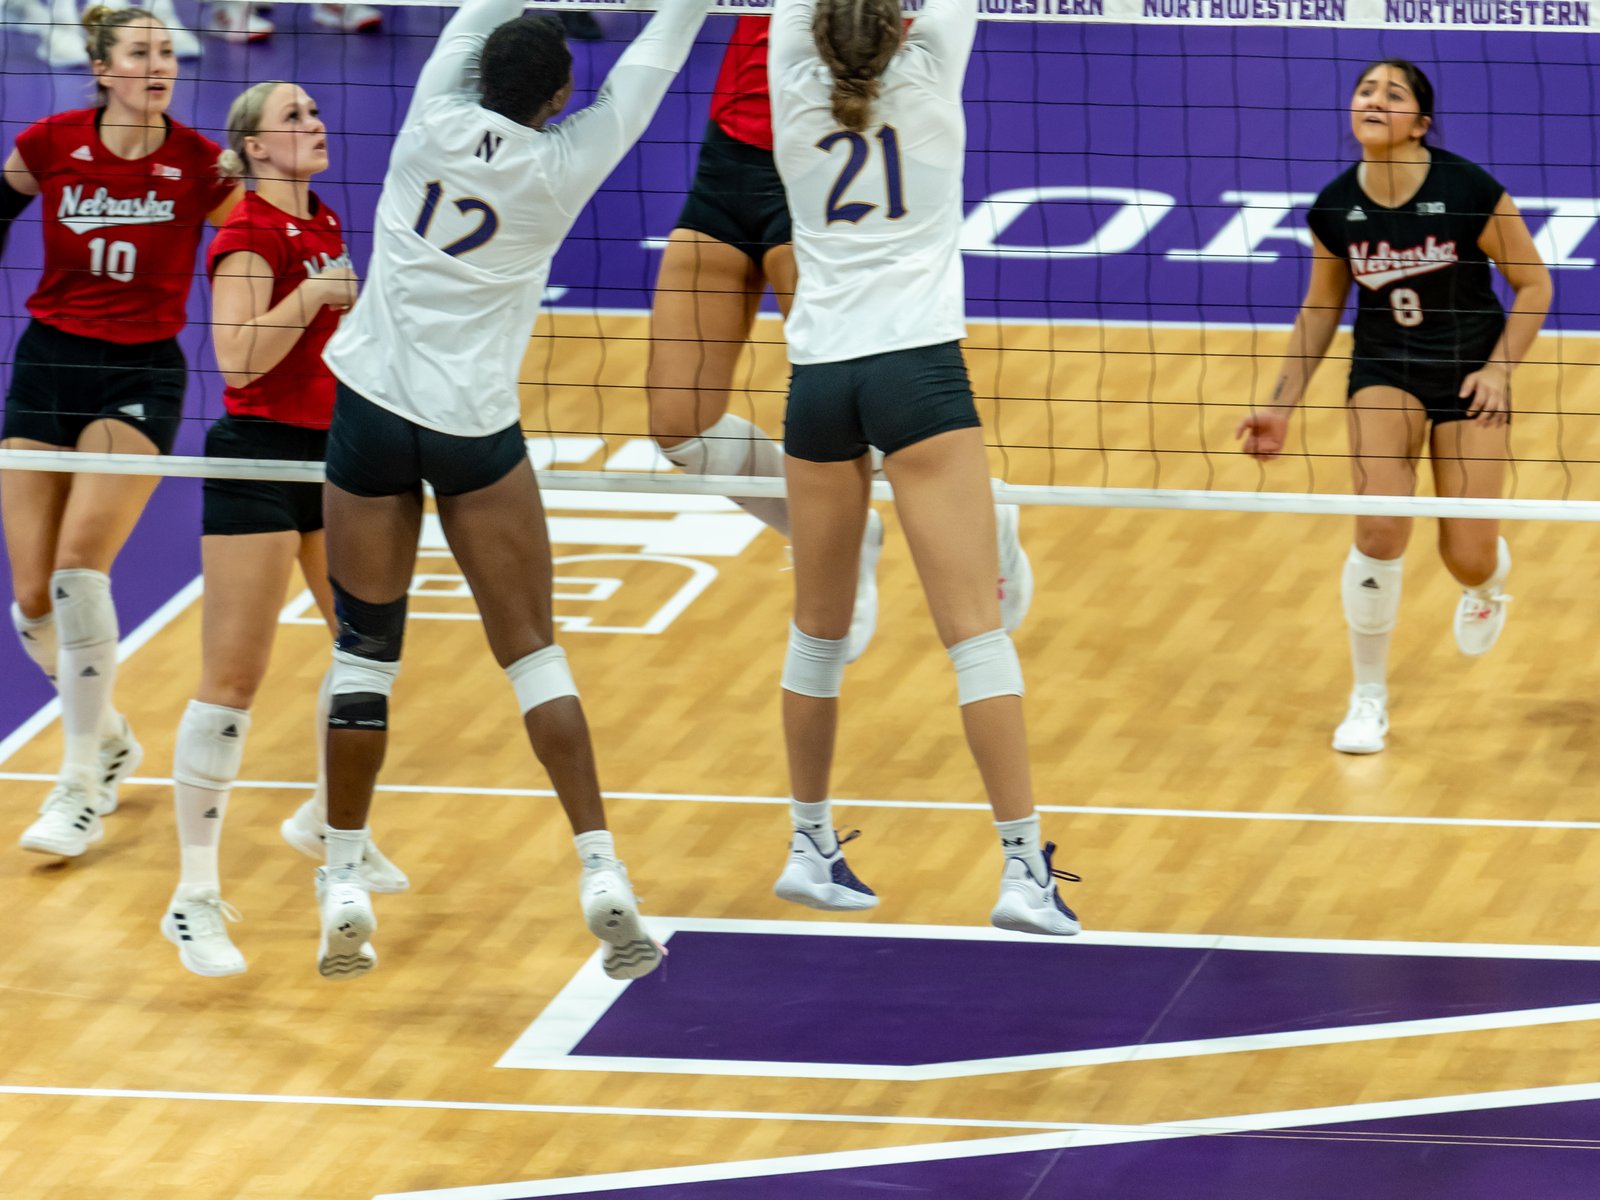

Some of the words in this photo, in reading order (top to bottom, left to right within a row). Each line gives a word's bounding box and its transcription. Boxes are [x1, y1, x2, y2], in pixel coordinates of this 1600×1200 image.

[474, 130, 503, 163] N
[814, 121, 909, 227] 21
[58, 184, 176, 222] Nebraska
[413, 179, 501, 258] 12
[88, 237, 138, 283] 10
[1348, 235, 1459, 281] Nebraska
